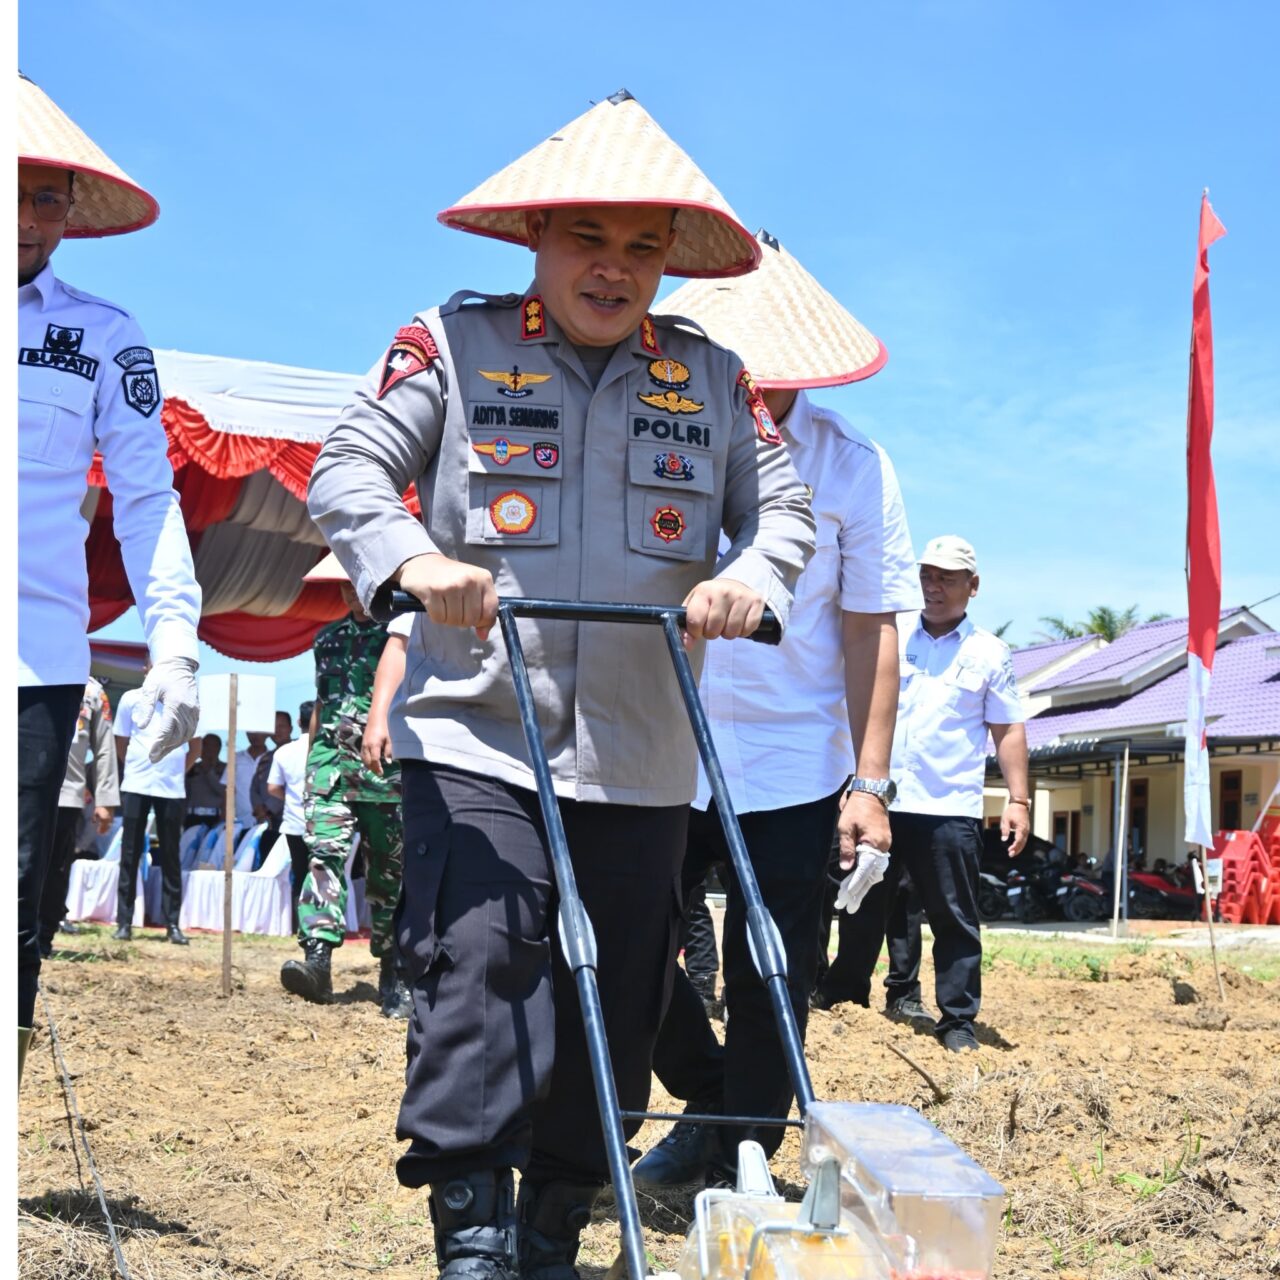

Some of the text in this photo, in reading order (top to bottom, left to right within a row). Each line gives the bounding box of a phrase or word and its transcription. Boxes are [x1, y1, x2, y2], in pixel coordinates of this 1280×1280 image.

[27, 351, 93, 375] BUPATI
[472, 405, 506, 425] ADITYA
[633, 417, 710, 447] POLRI
